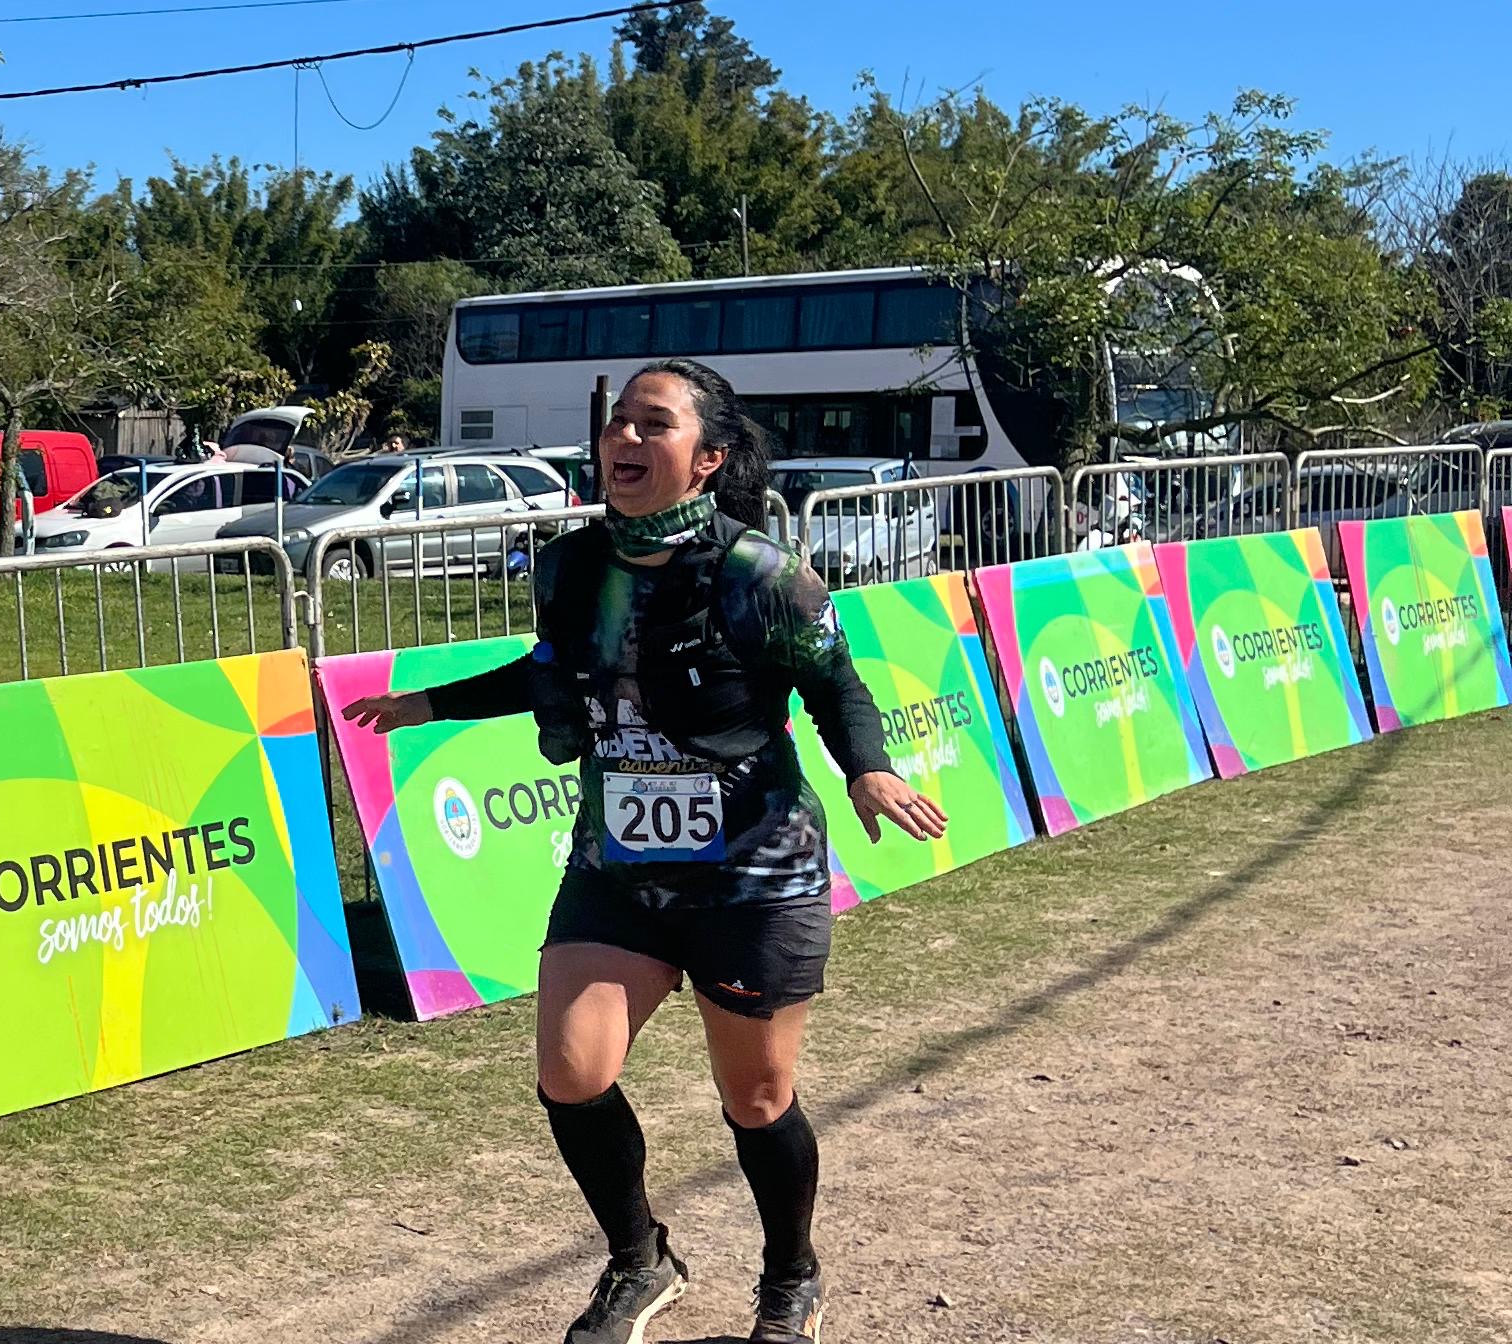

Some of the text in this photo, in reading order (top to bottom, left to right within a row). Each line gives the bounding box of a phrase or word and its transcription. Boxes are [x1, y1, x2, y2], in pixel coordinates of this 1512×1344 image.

[1398, 594, 1479, 630] CORRIENTES
[1232, 622, 1323, 662] CORRIENTES
[1062, 645, 1159, 699] CORRIENTES
[879, 690, 973, 748] RRIENTES
[618, 796, 719, 843] 205
[37, 905, 128, 964] somos
